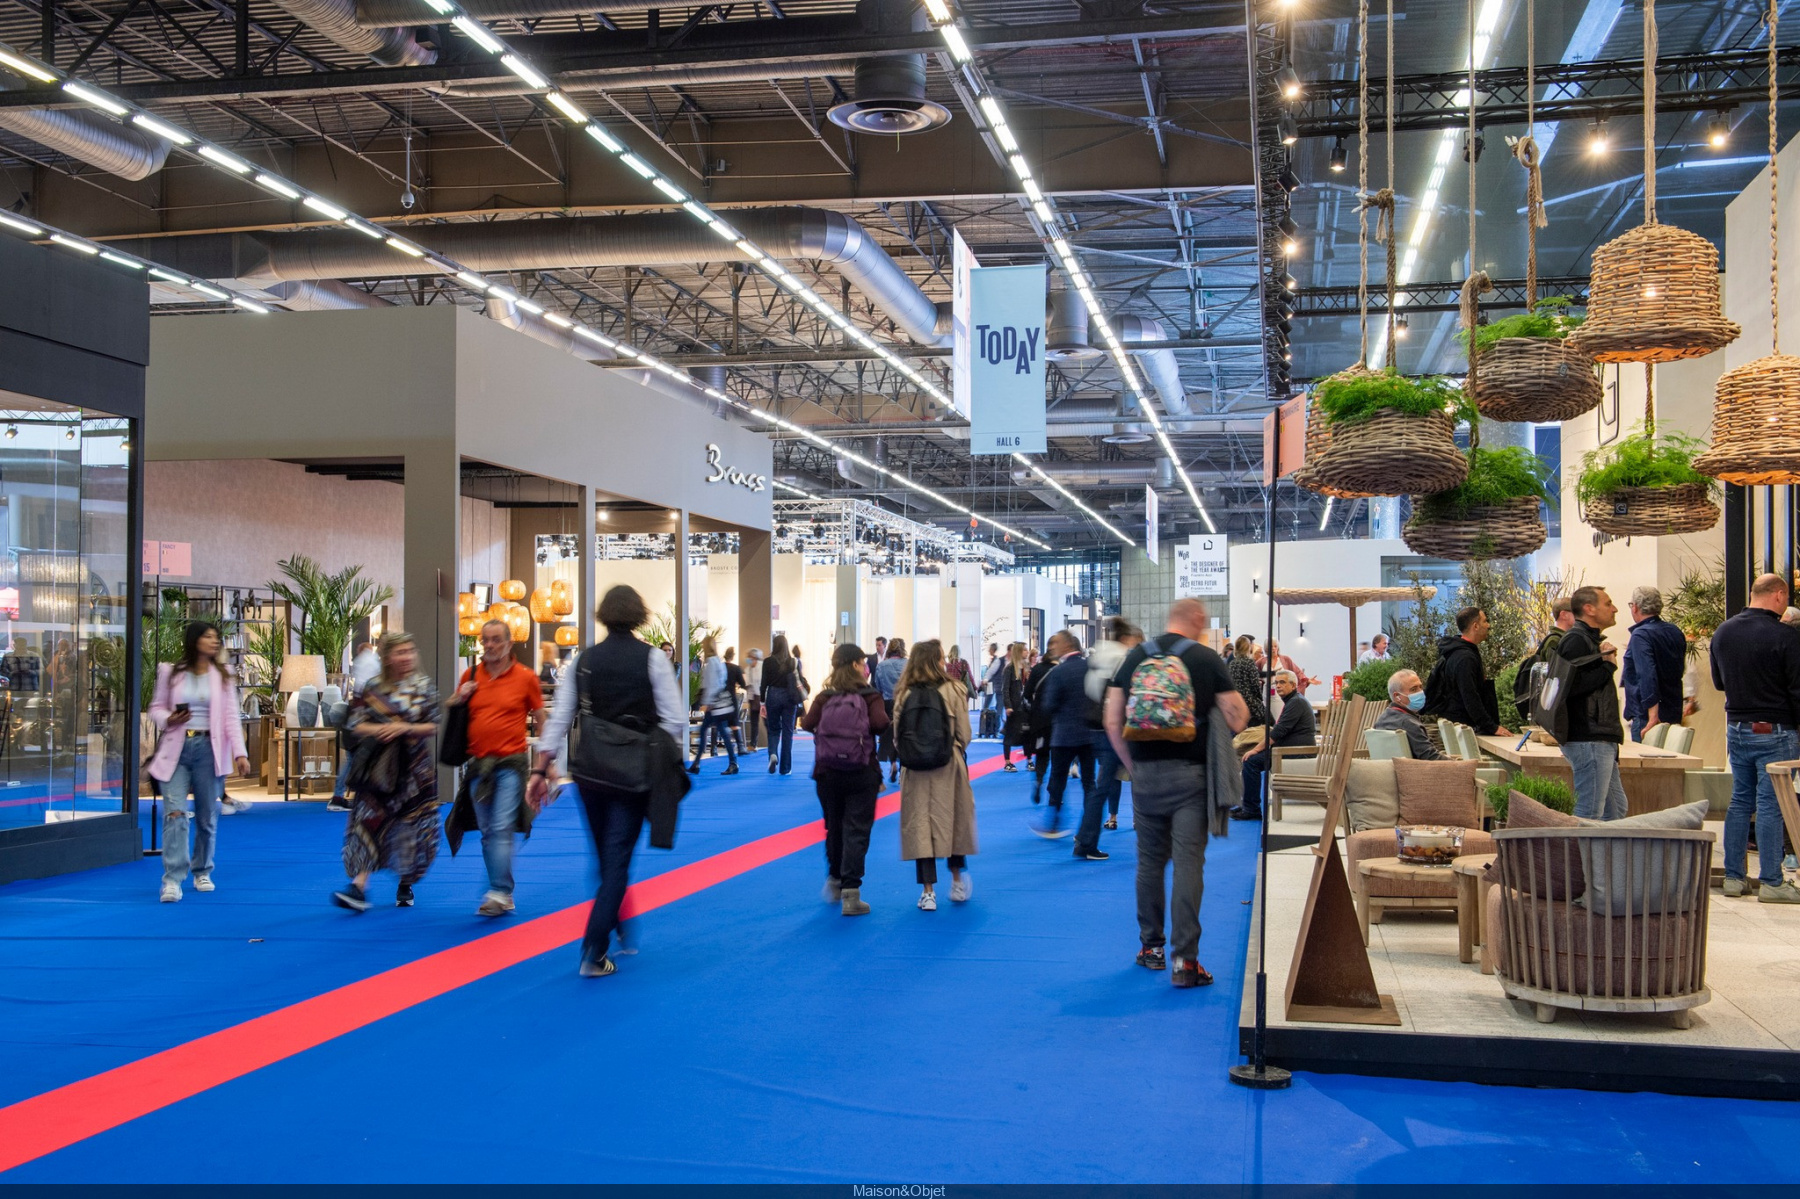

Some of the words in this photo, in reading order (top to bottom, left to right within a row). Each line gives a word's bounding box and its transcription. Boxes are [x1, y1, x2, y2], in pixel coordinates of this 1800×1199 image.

[976, 324, 1040, 374] TODAY
[996, 437, 1013, 447] HALL
[1015, 436, 1021, 446] 6
